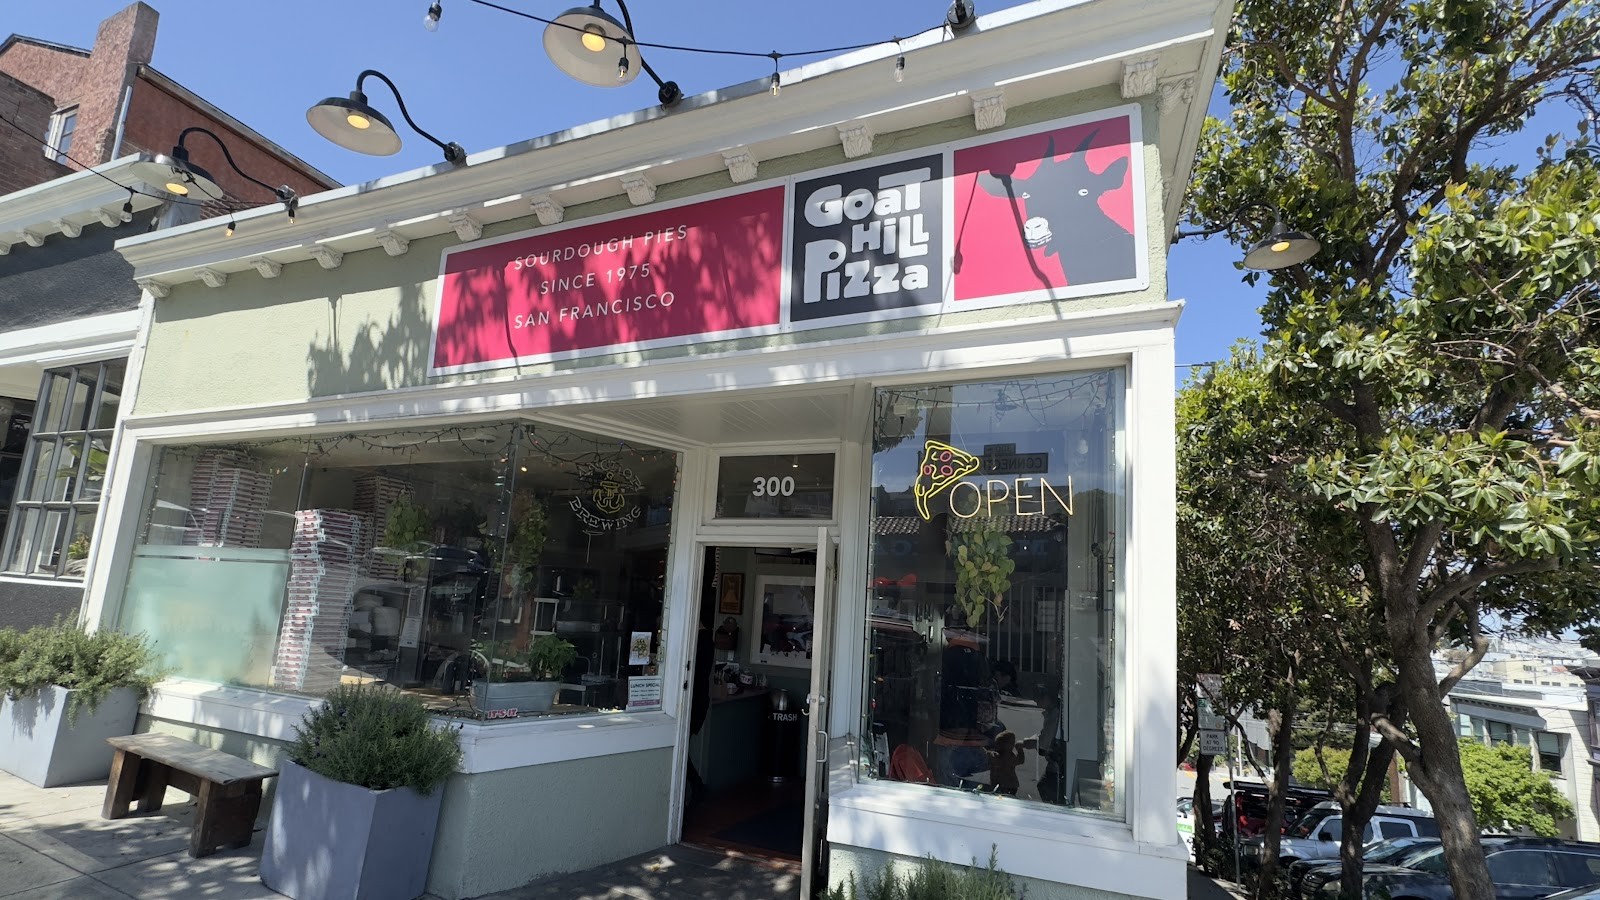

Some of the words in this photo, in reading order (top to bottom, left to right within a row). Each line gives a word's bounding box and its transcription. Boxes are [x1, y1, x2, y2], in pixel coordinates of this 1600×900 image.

[513, 234, 634, 271] SOURDOUGH
[644, 224, 687, 245] PIES
[540, 274, 596, 295] SINCE
[605, 263, 651, 284] 1975
[803, 238, 929, 304] Pizza
[514, 310, 550, 329] SAN
[559, 292, 675, 322] FRANCISCO
[752, 476, 795, 497] 300
[949, 475, 1074, 518] OPEN
[569, 496, 642, 530] BREWING
[772, 712, 798, 721] TRASH
